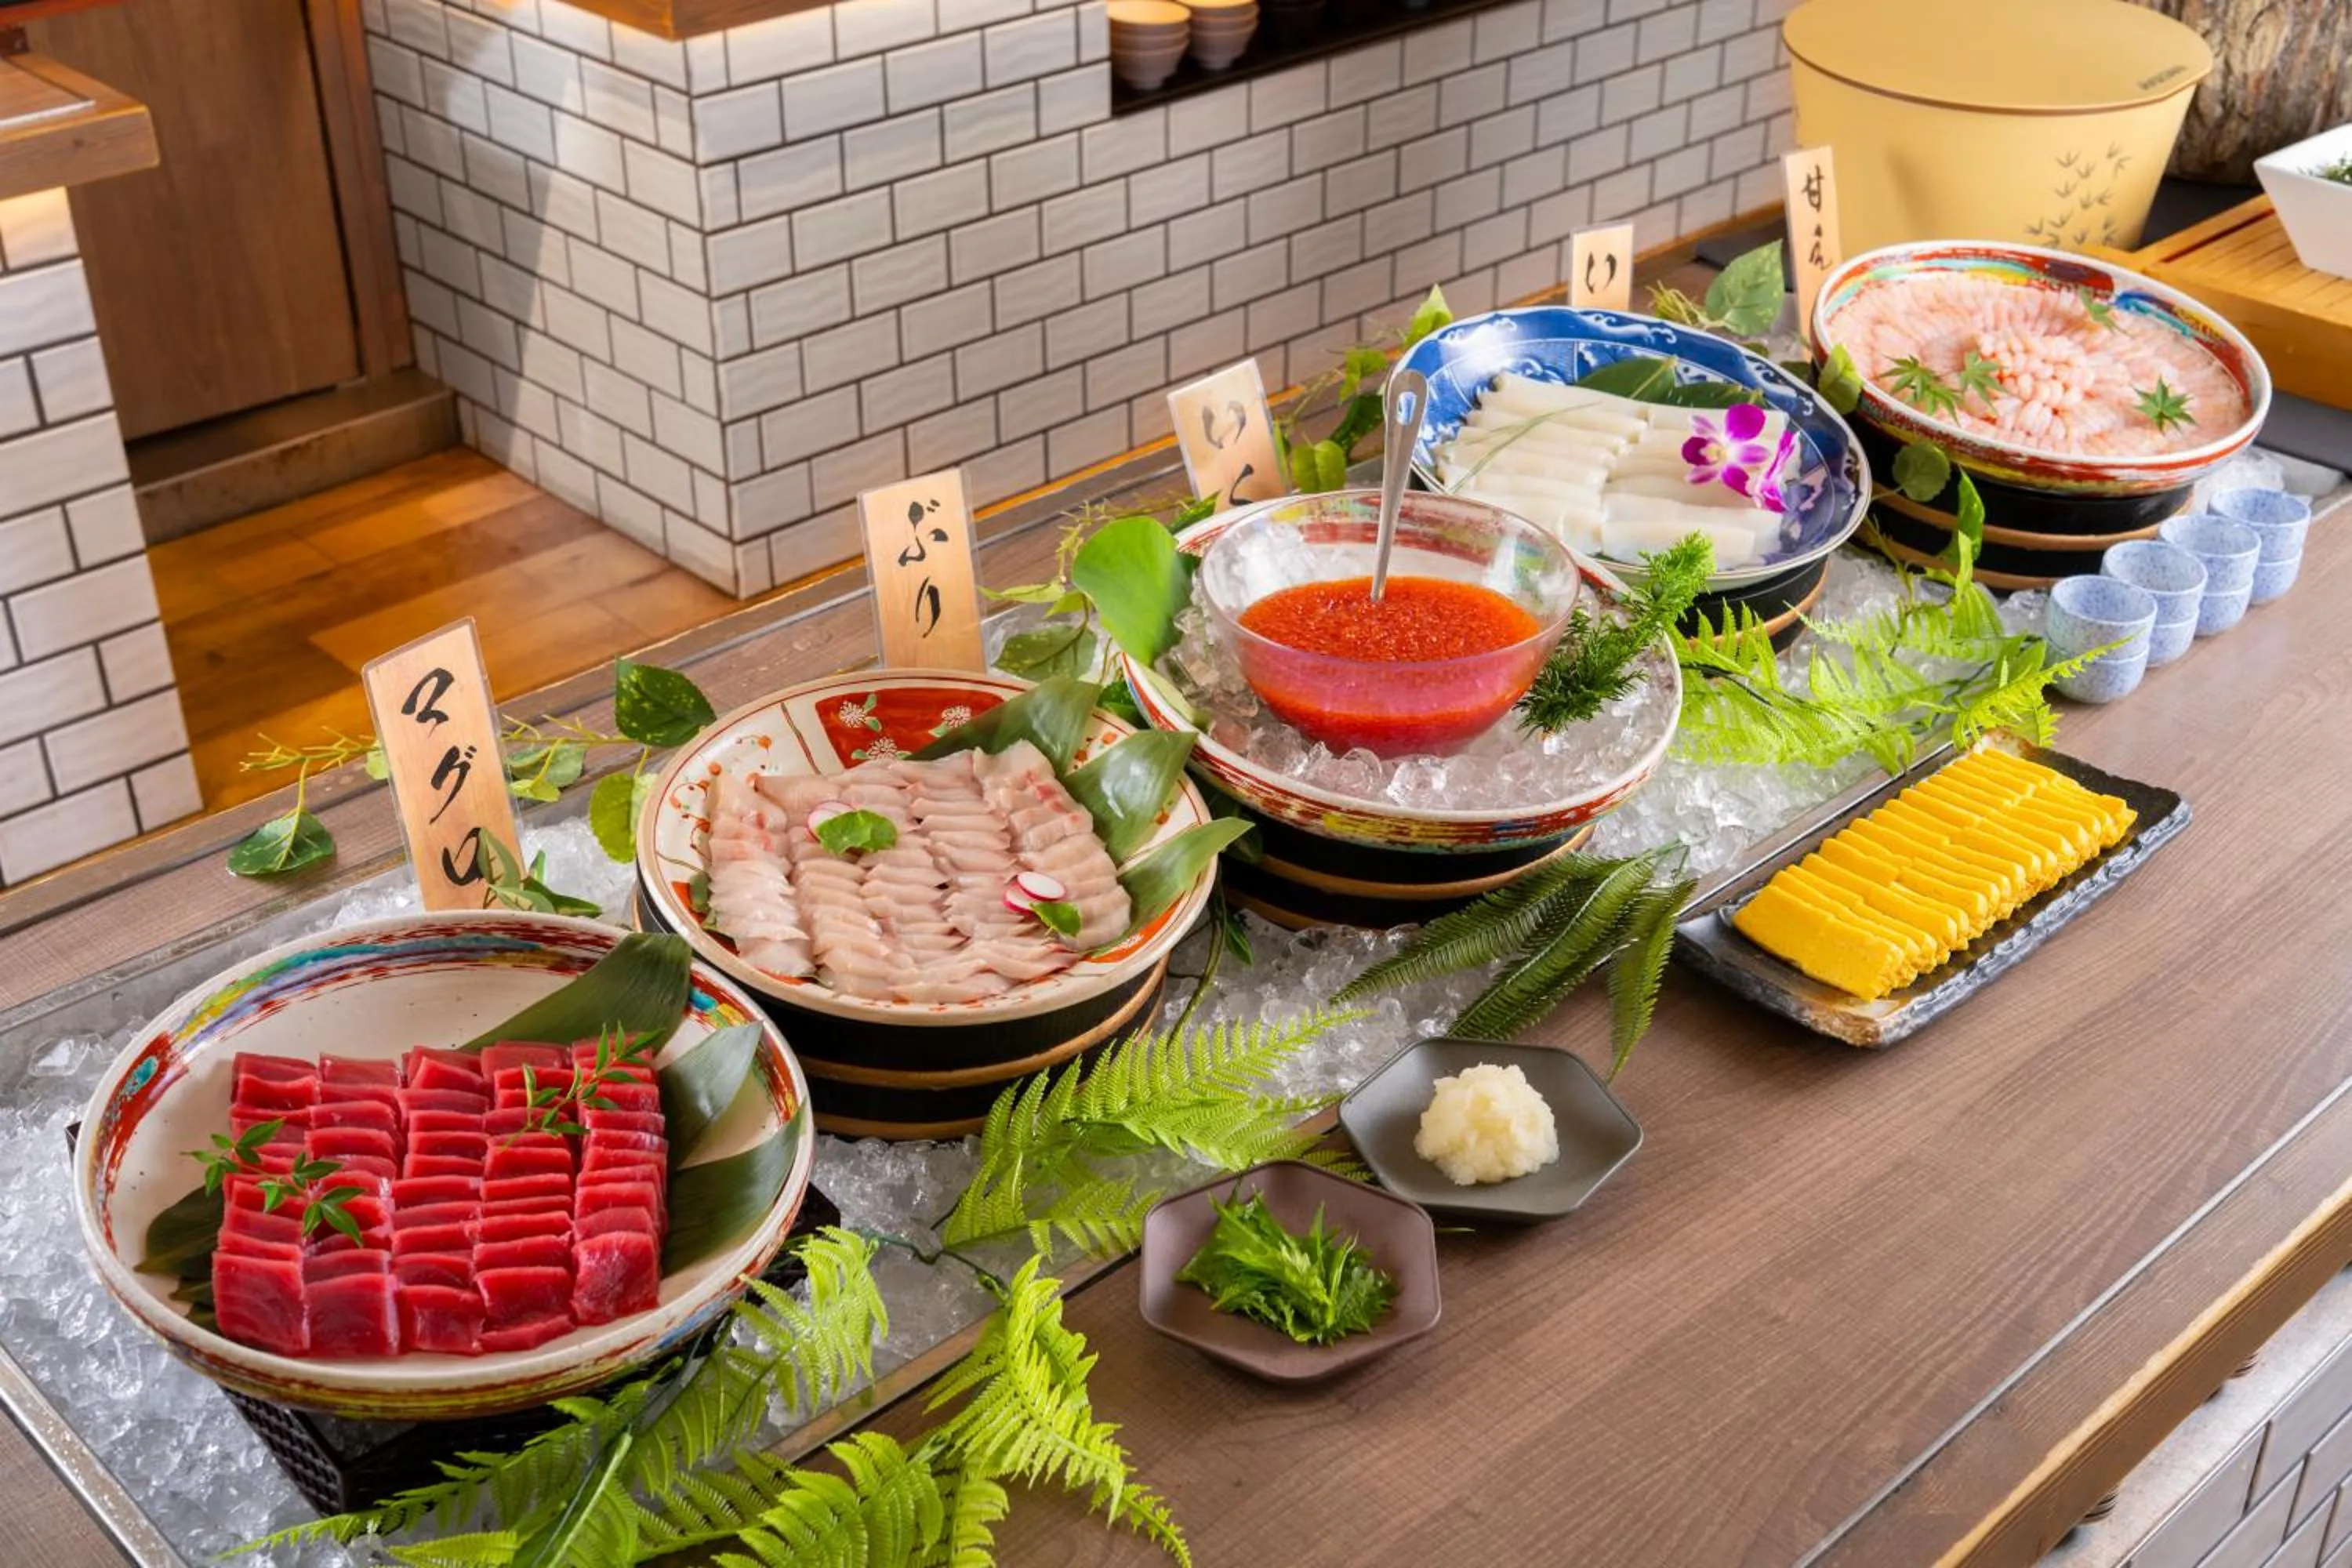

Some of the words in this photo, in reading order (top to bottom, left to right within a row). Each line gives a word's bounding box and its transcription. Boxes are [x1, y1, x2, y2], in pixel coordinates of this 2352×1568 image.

[897, 499, 949, 639] ぶり
[401, 667, 485, 886] マグロ
